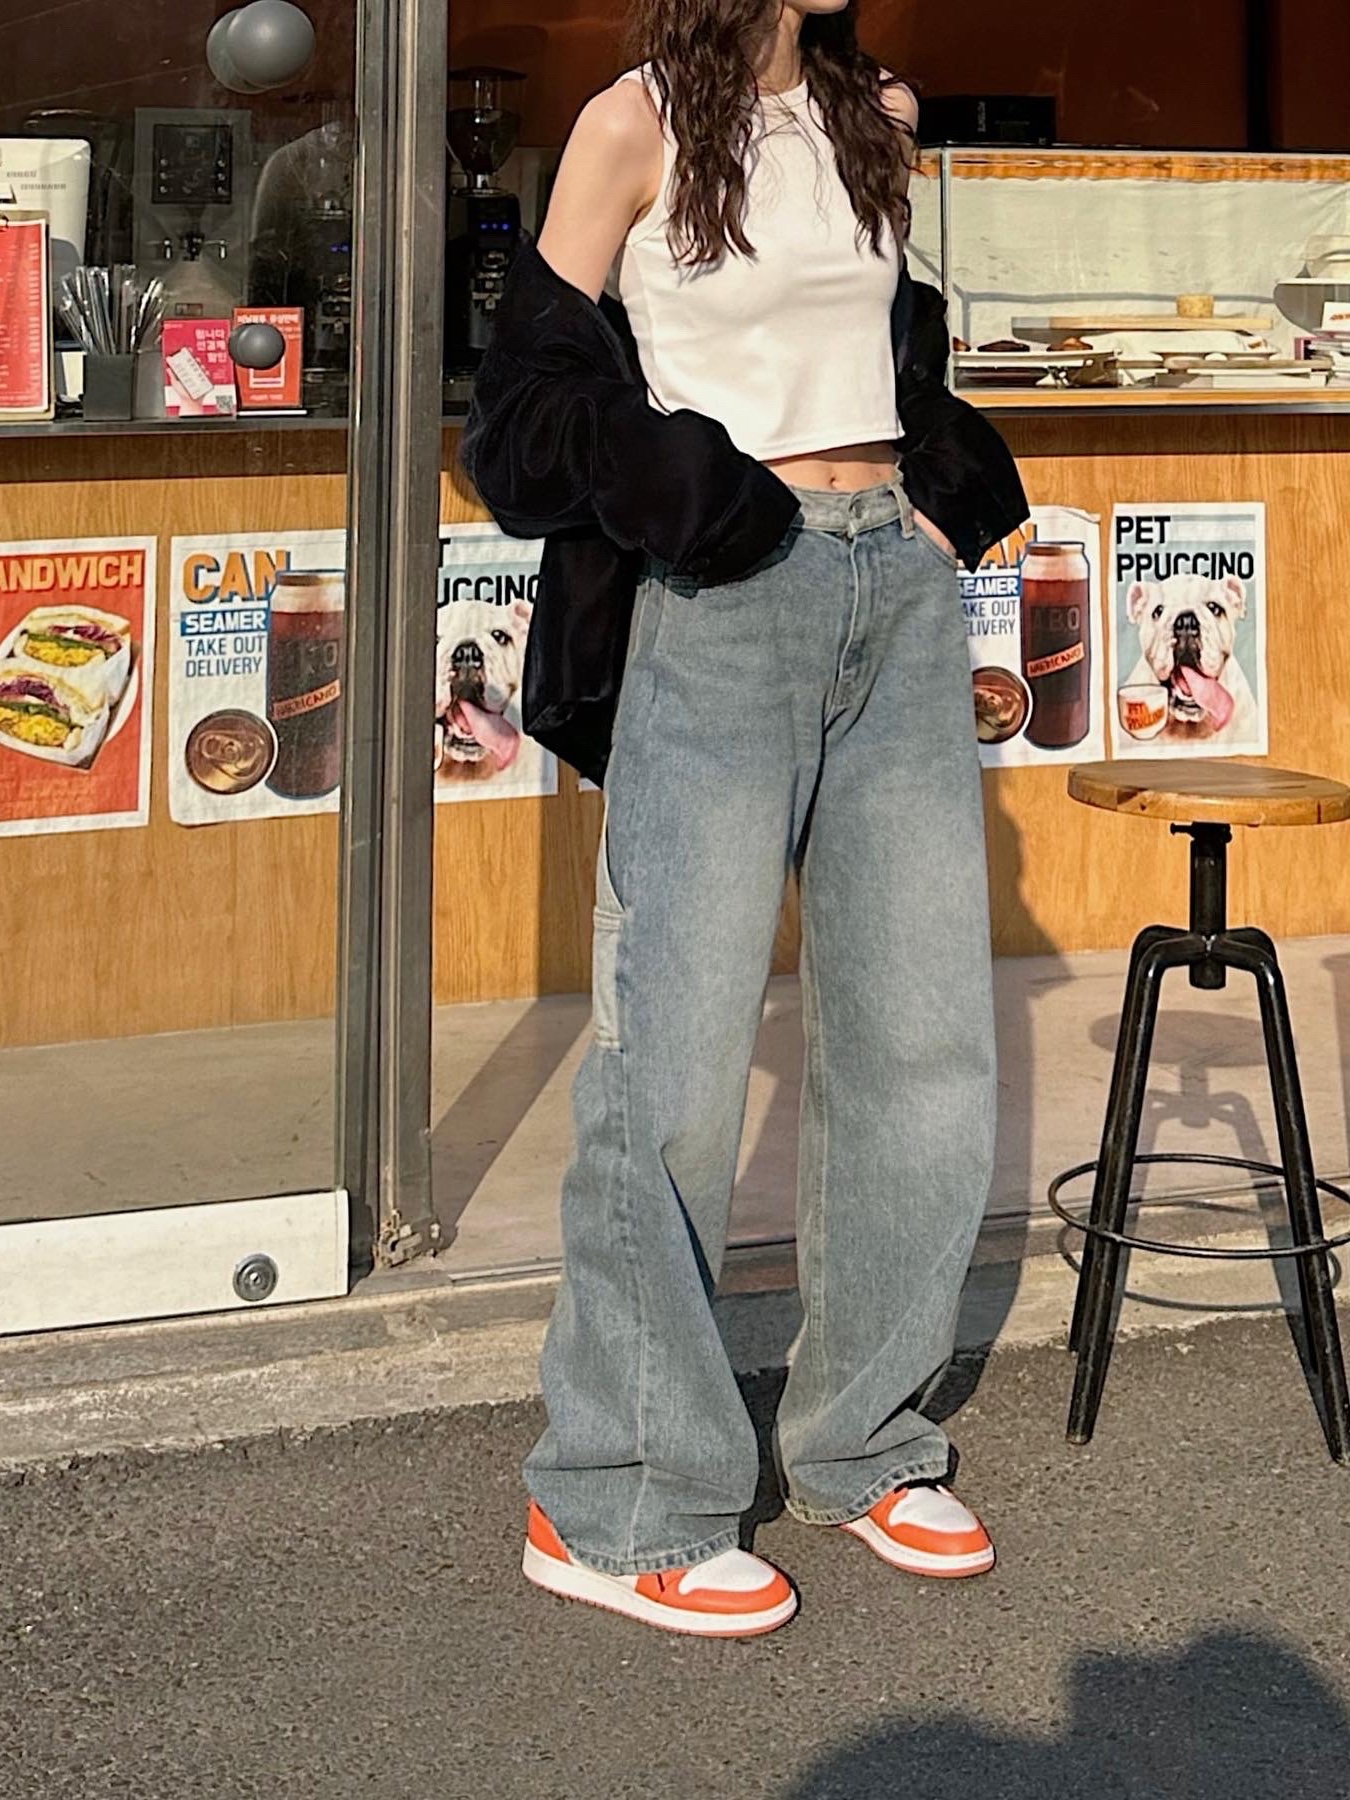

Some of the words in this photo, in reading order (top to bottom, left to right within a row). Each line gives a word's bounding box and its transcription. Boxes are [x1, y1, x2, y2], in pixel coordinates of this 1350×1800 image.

[1116, 515, 1171, 544] PET
[980, 522, 1037, 570] AN
[183, 549, 290, 605] CAN
[1116, 552, 1254, 582] PPUCCINO
[958, 577, 1018, 597] EAMER
[991, 600, 1016, 616] OUT
[185, 610, 266, 634] SEAMER
[186, 638, 227, 657] TAKE
[233, 635, 265, 654] OUT
[186, 657, 262, 677] DELIVERY
